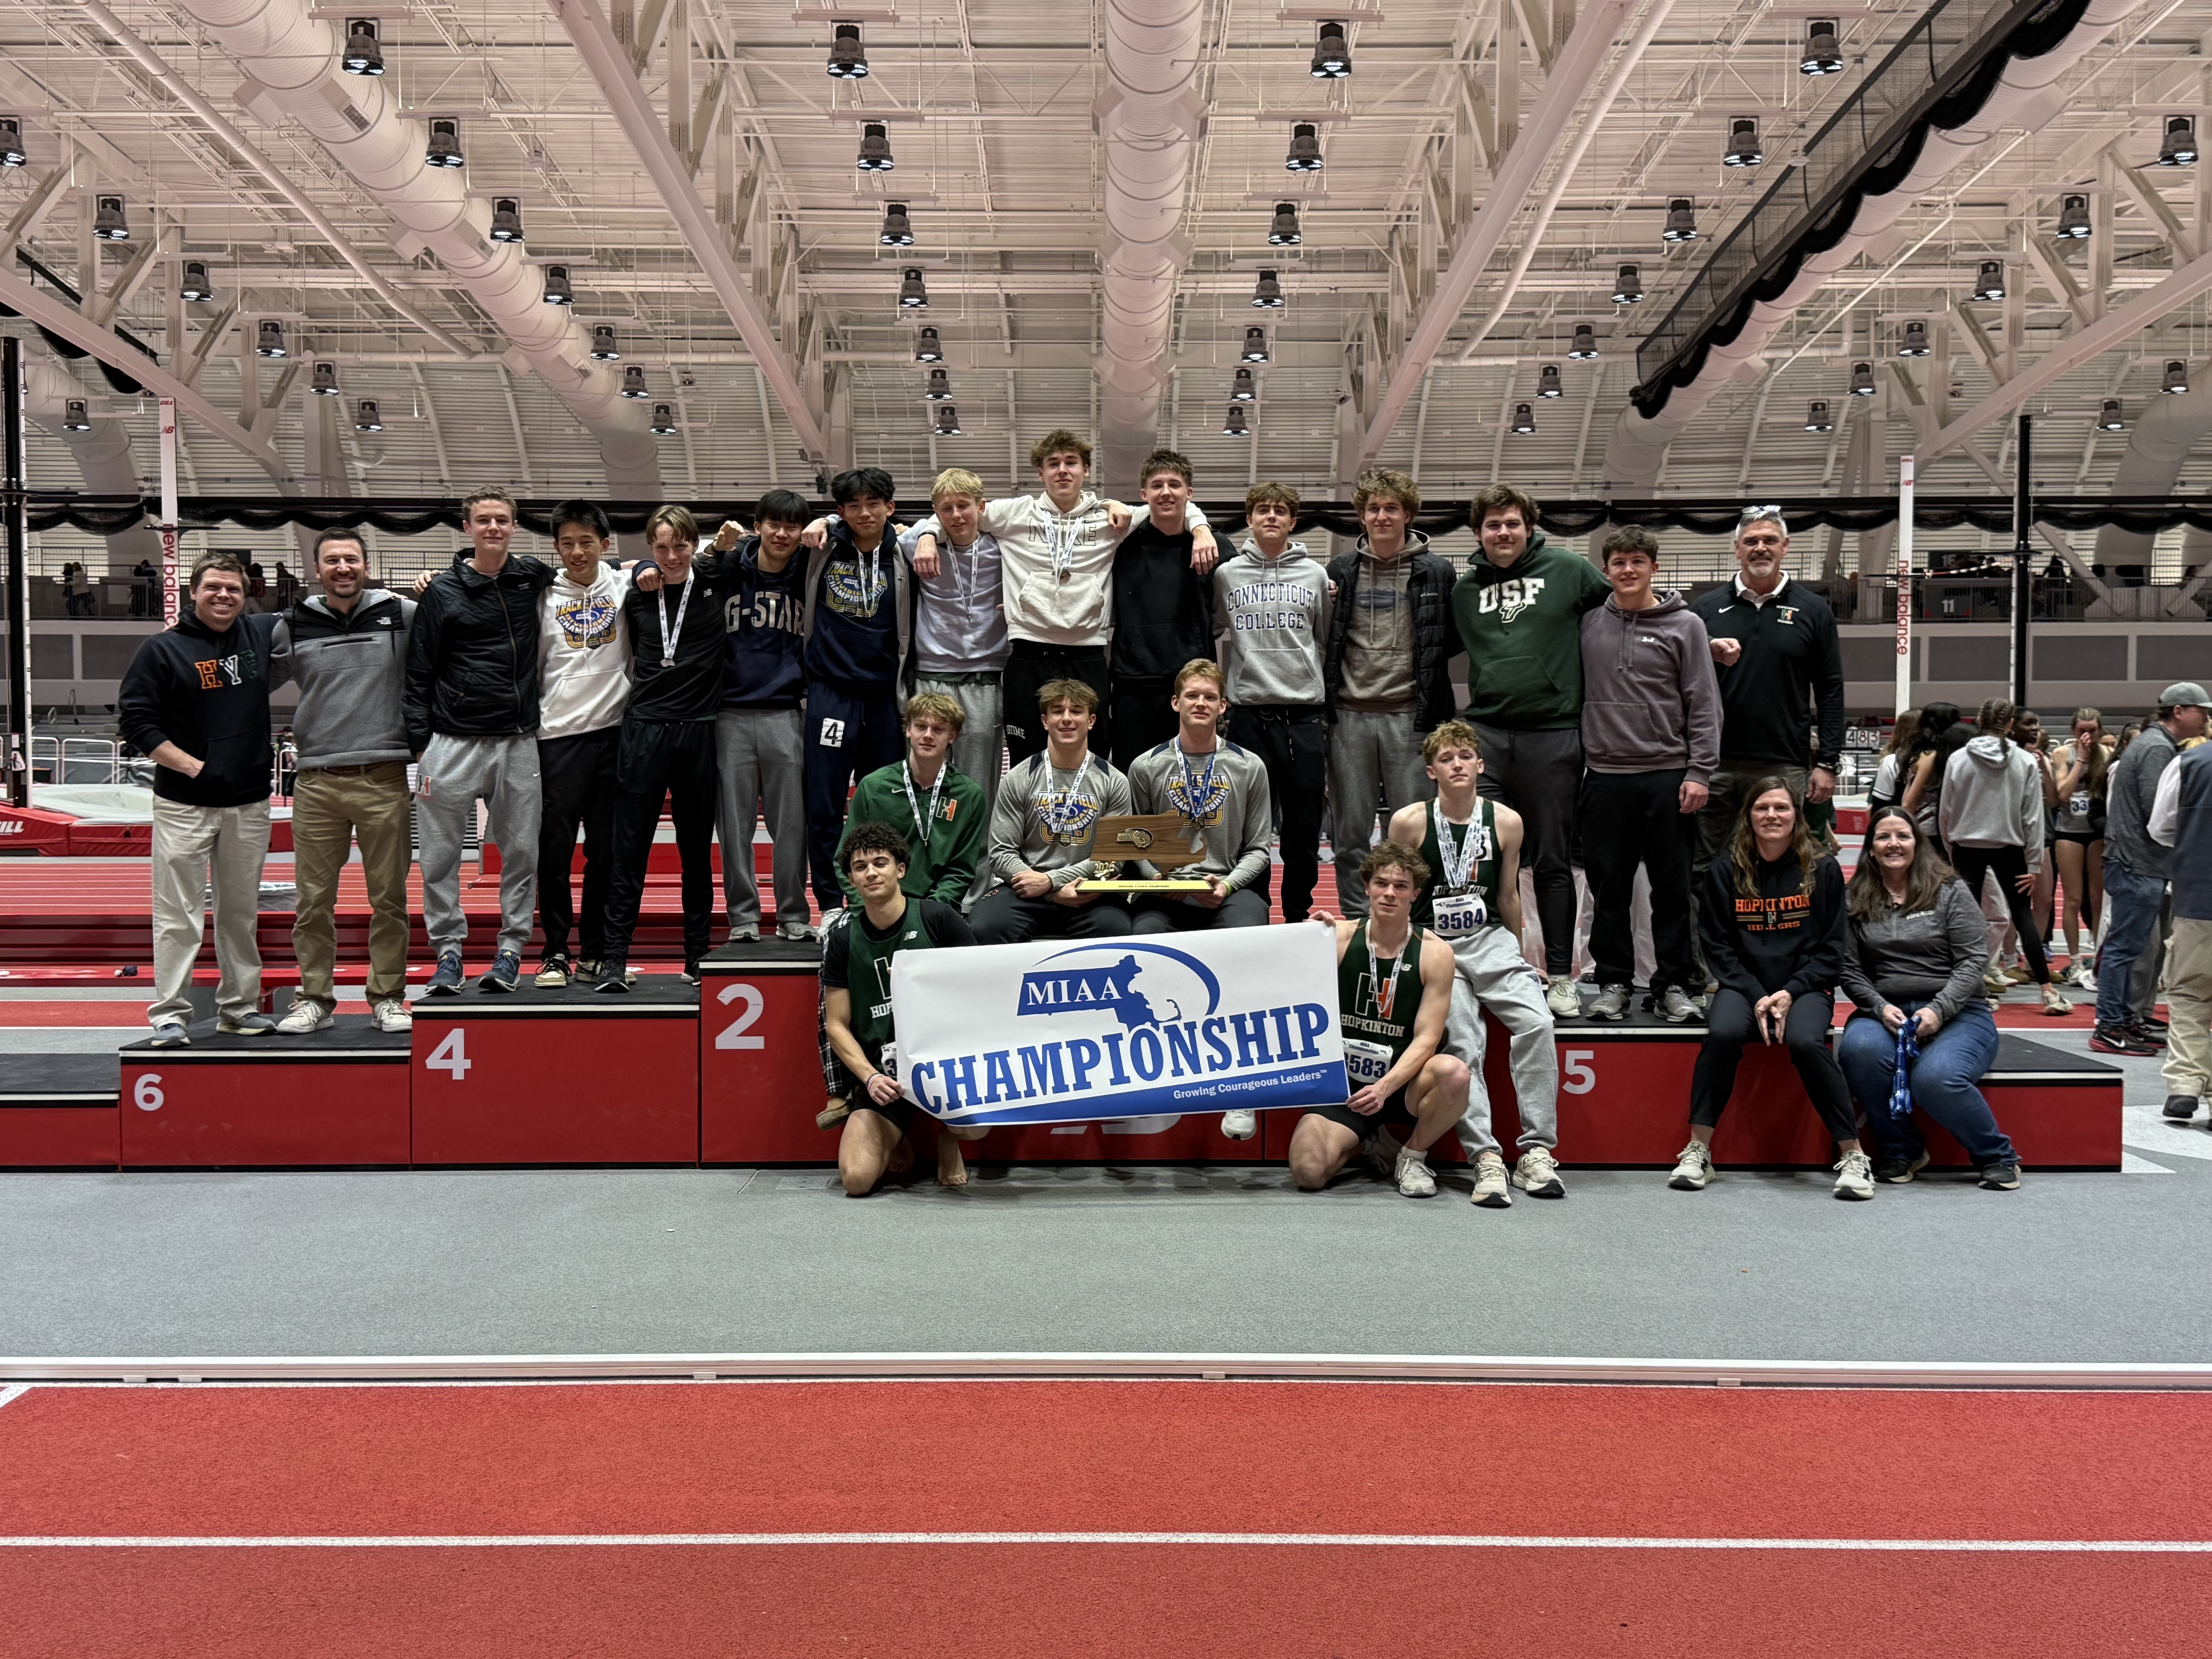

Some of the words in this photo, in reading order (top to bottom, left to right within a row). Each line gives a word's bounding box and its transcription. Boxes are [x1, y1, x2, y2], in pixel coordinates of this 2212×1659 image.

[557, 599, 582, 617] TRACK
[1228, 582, 1314, 612] CONNECTICUT
[1479, 577, 1545, 614] USF
[1941, 599, 1954, 613] 11
[1235, 611, 1305, 631] COLLEGE
[1897, 594, 1911, 655] balance
[824, 721, 838, 745] 4
[0, 821, 24, 833] ILL
[1438, 908, 1483, 930] 3584
[1025, 975, 1123, 1007] MIAA
[715, 983, 765, 1049] 2
[1341, 1013, 1405, 1037] HOPKINTON
[425, 1028, 472, 1080] 4
[911, 1002, 1329, 1115] CHAMPIONSHIP
[1562, 1049, 1596, 1095] 5
[134, 1073, 165, 1111] 6
[1173, 1085, 1216, 1099] Growing
[1218, 1077, 1279, 1093] Courageous
